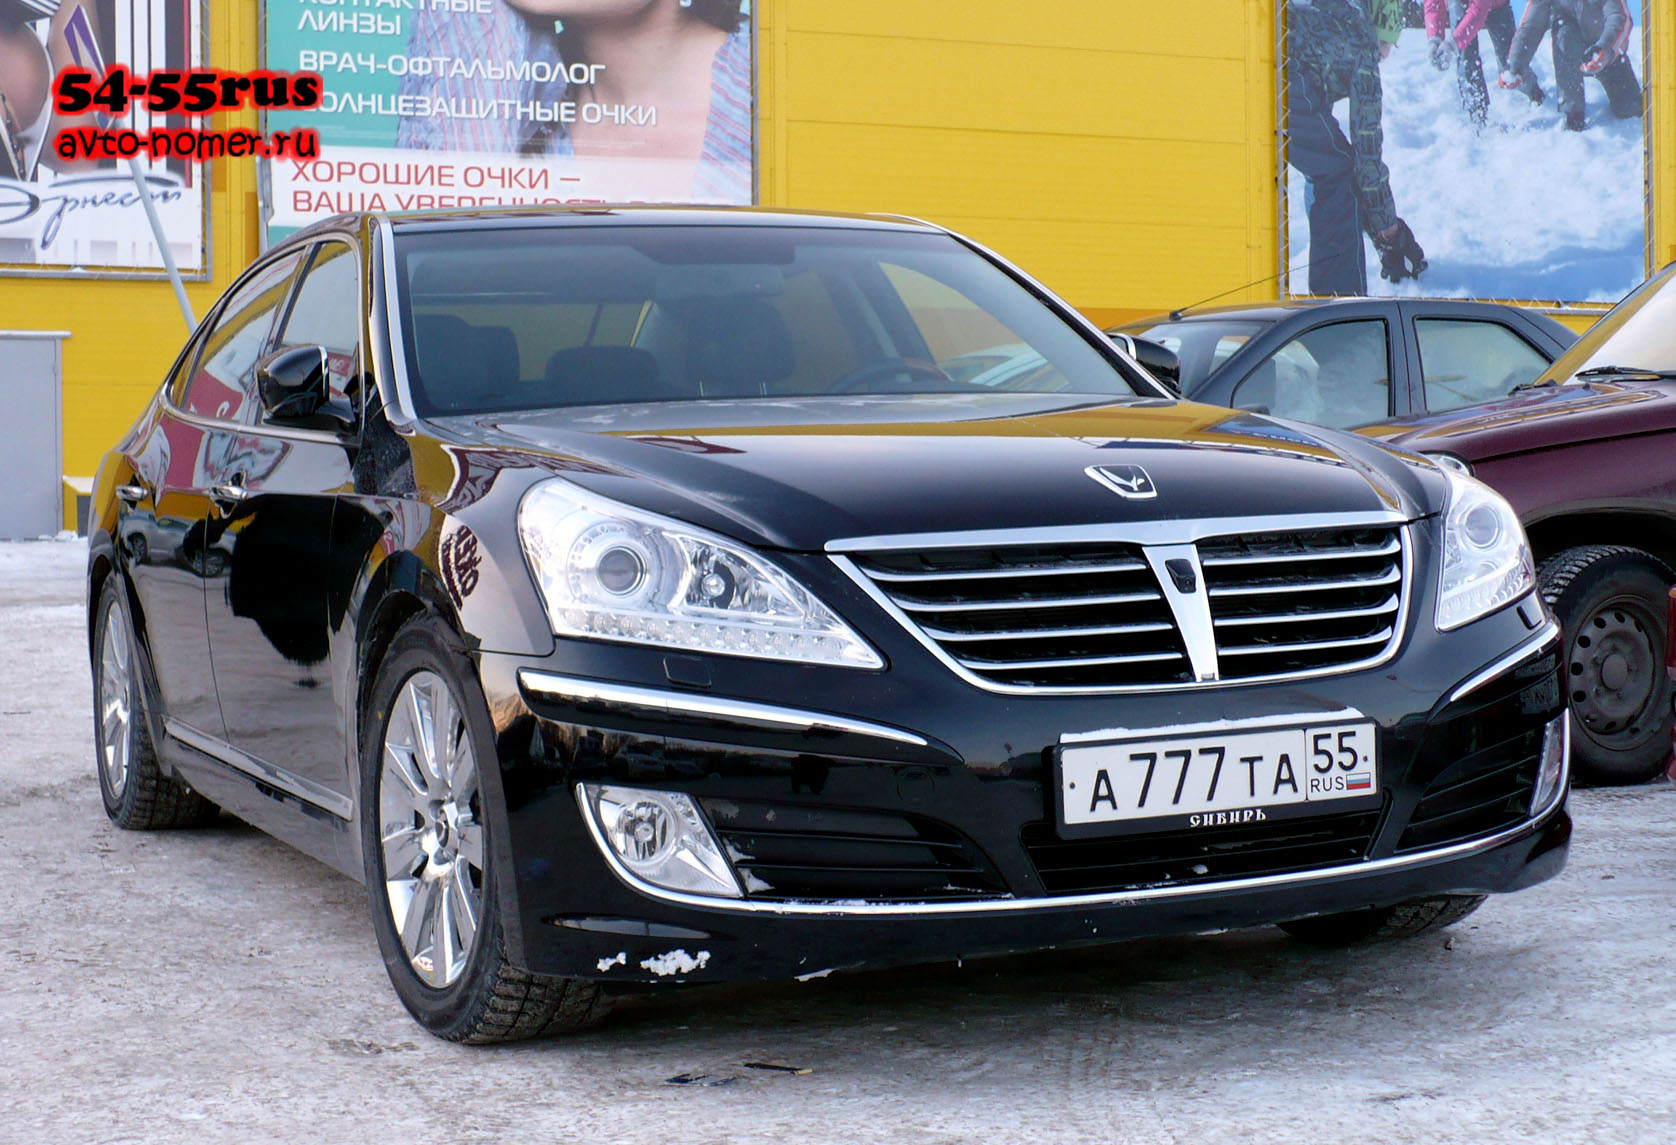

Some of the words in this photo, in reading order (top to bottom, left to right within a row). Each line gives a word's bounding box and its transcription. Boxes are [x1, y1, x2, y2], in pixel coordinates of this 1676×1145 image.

[298, 10, 401, 35] ЛИНЗЫ
[299, 50, 606, 85] ВРАЧ-ОФТАЛЬМОЛОГ
[302, 92, 576, 123] ОЛНЦЕЗАЩИТНЫЕ
[581, 104, 657, 127] ОЧКИ
[291, 160, 455, 187] ХОРОШИЕ
[463, 166, 550, 190] ОЧКИ
[293, 190, 386, 213] ВАША
[1313, 731, 1358, 774] 55
[1310, 776, 1345, 793] RUS
[1189, 808, 1267, 828] СИБИРЬ
